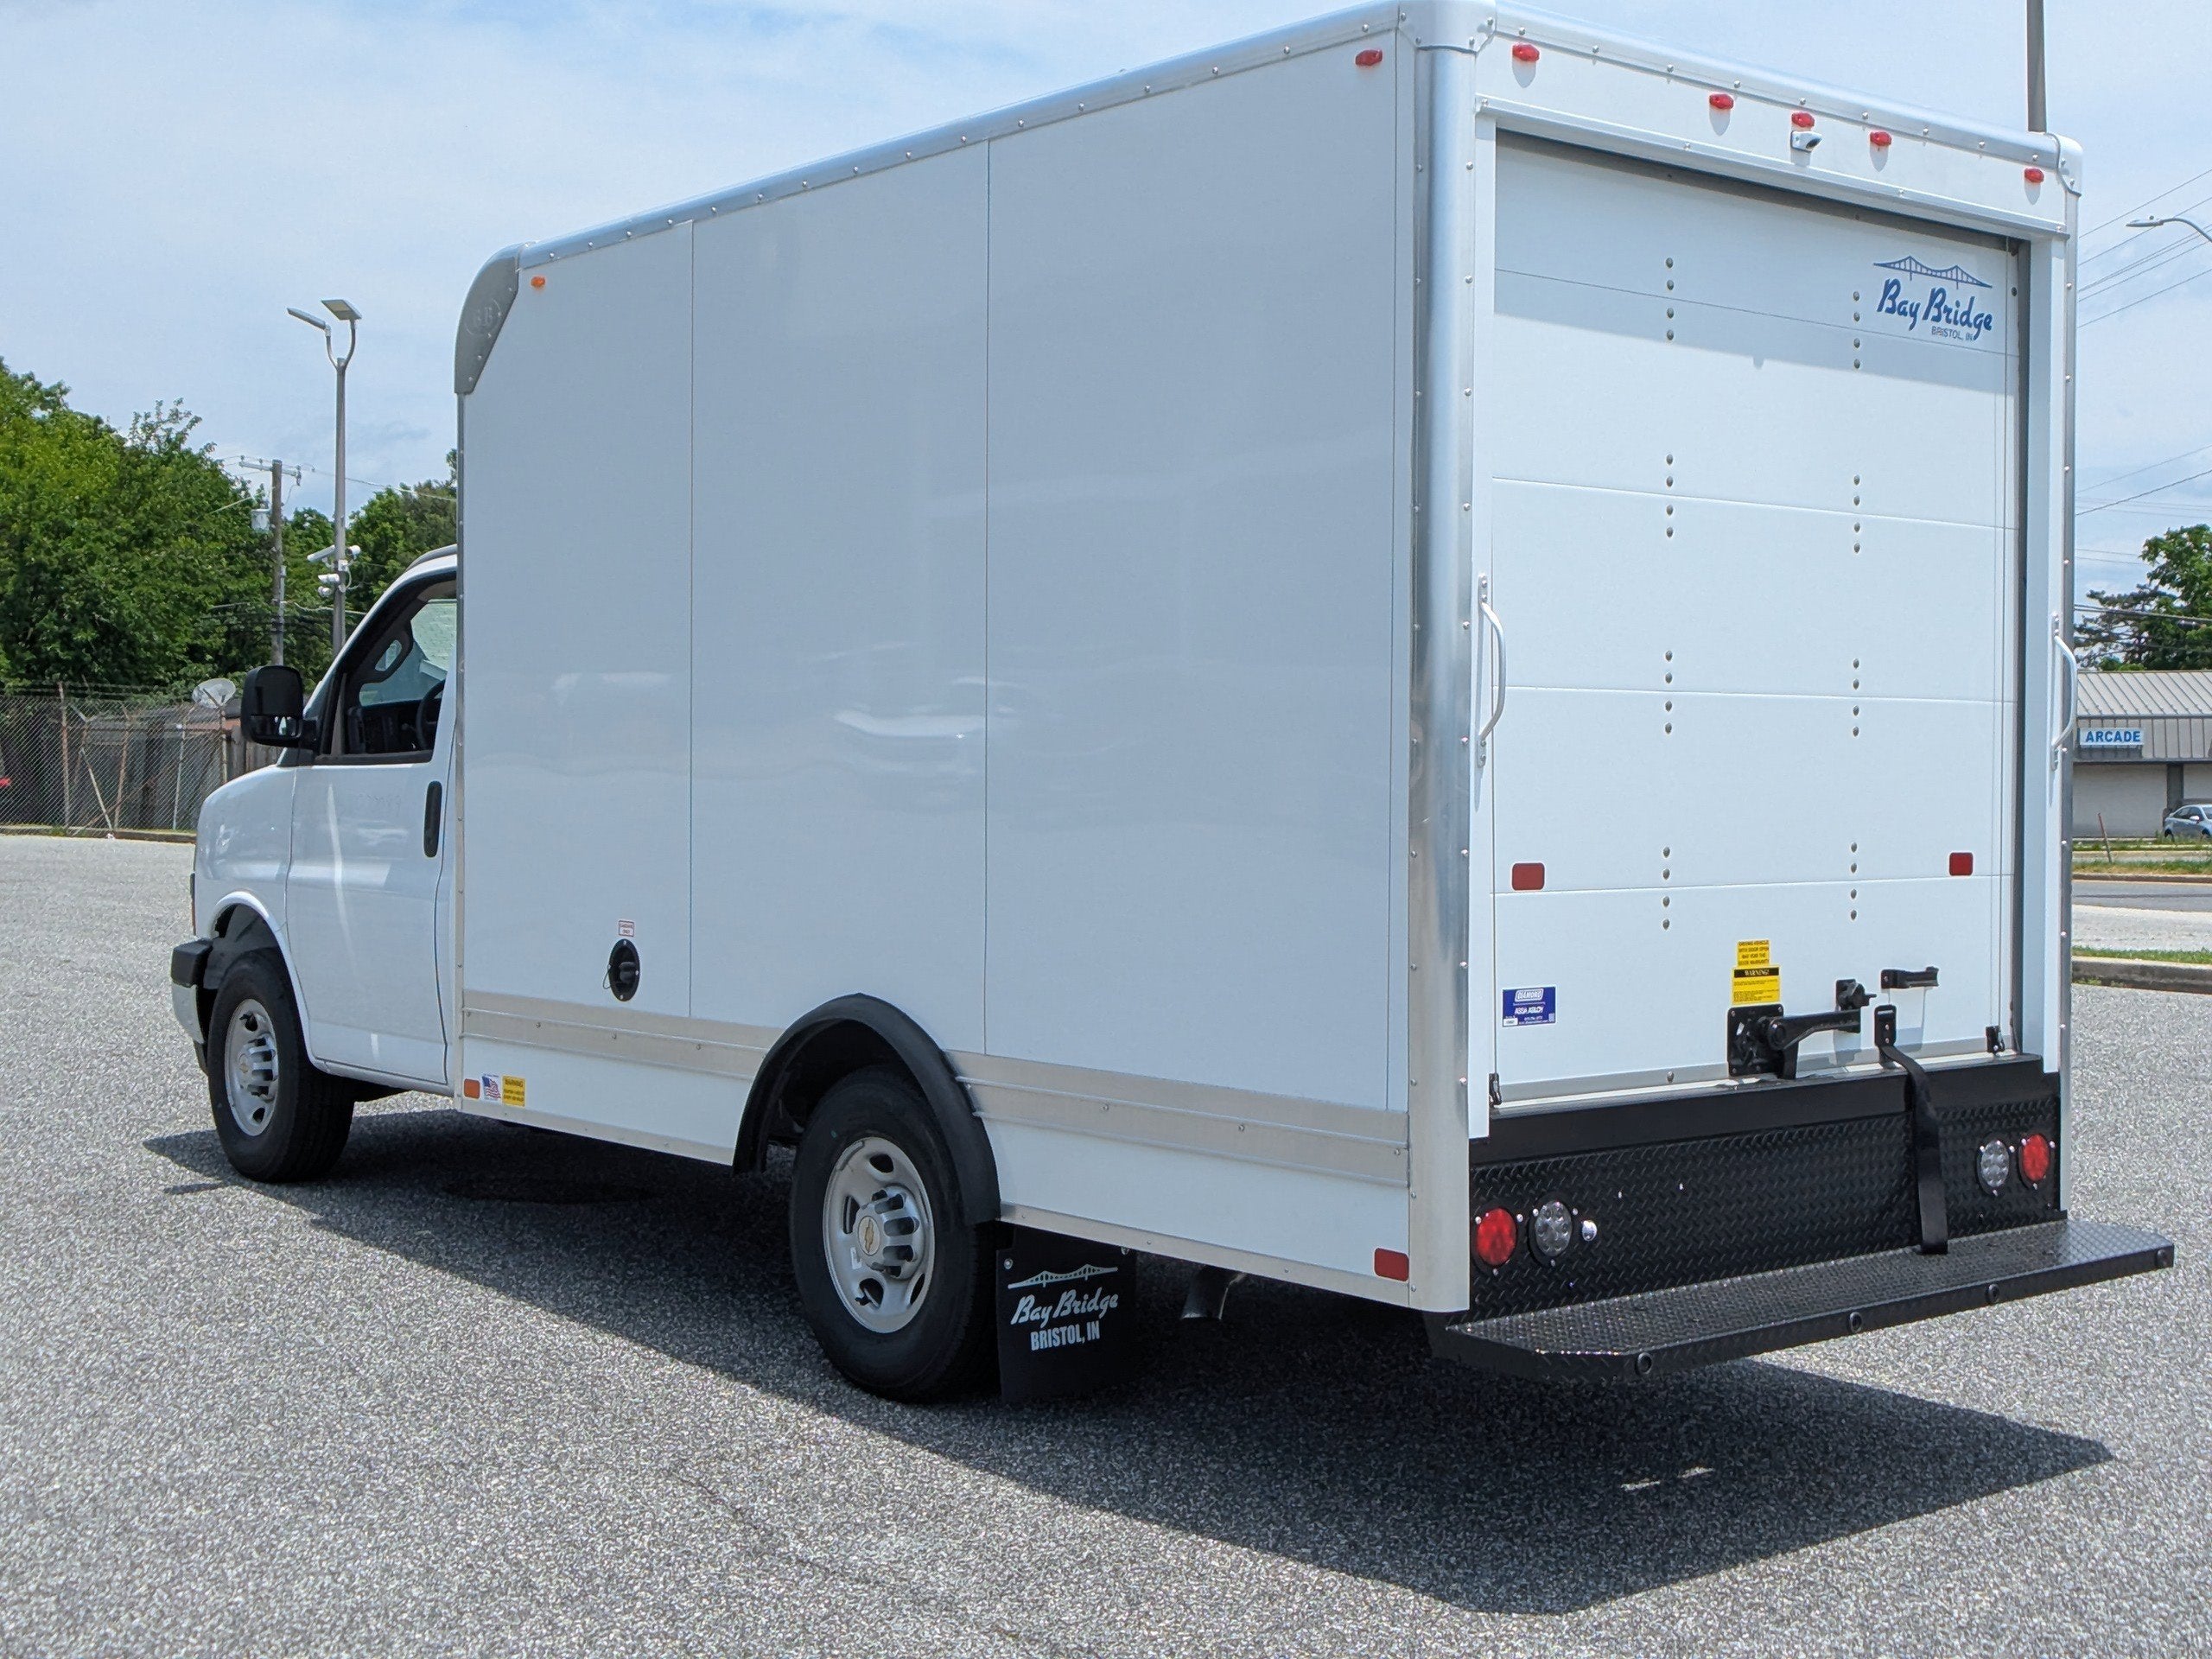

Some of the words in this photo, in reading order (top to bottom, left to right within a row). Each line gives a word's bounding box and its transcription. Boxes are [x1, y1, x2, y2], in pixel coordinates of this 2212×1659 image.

[1876, 278, 1921, 331] Bay
[1922, 287, 1993, 340] Bridge
[1965, 333, 1974, 341] IN
[2085, 731, 2140, 742] ARCADE
[1010, 1294, 1052, 1328] Bay
[1052, 1287, 1119, 1319] Bridge
[1086, 1320, 1100, 1341] IN
